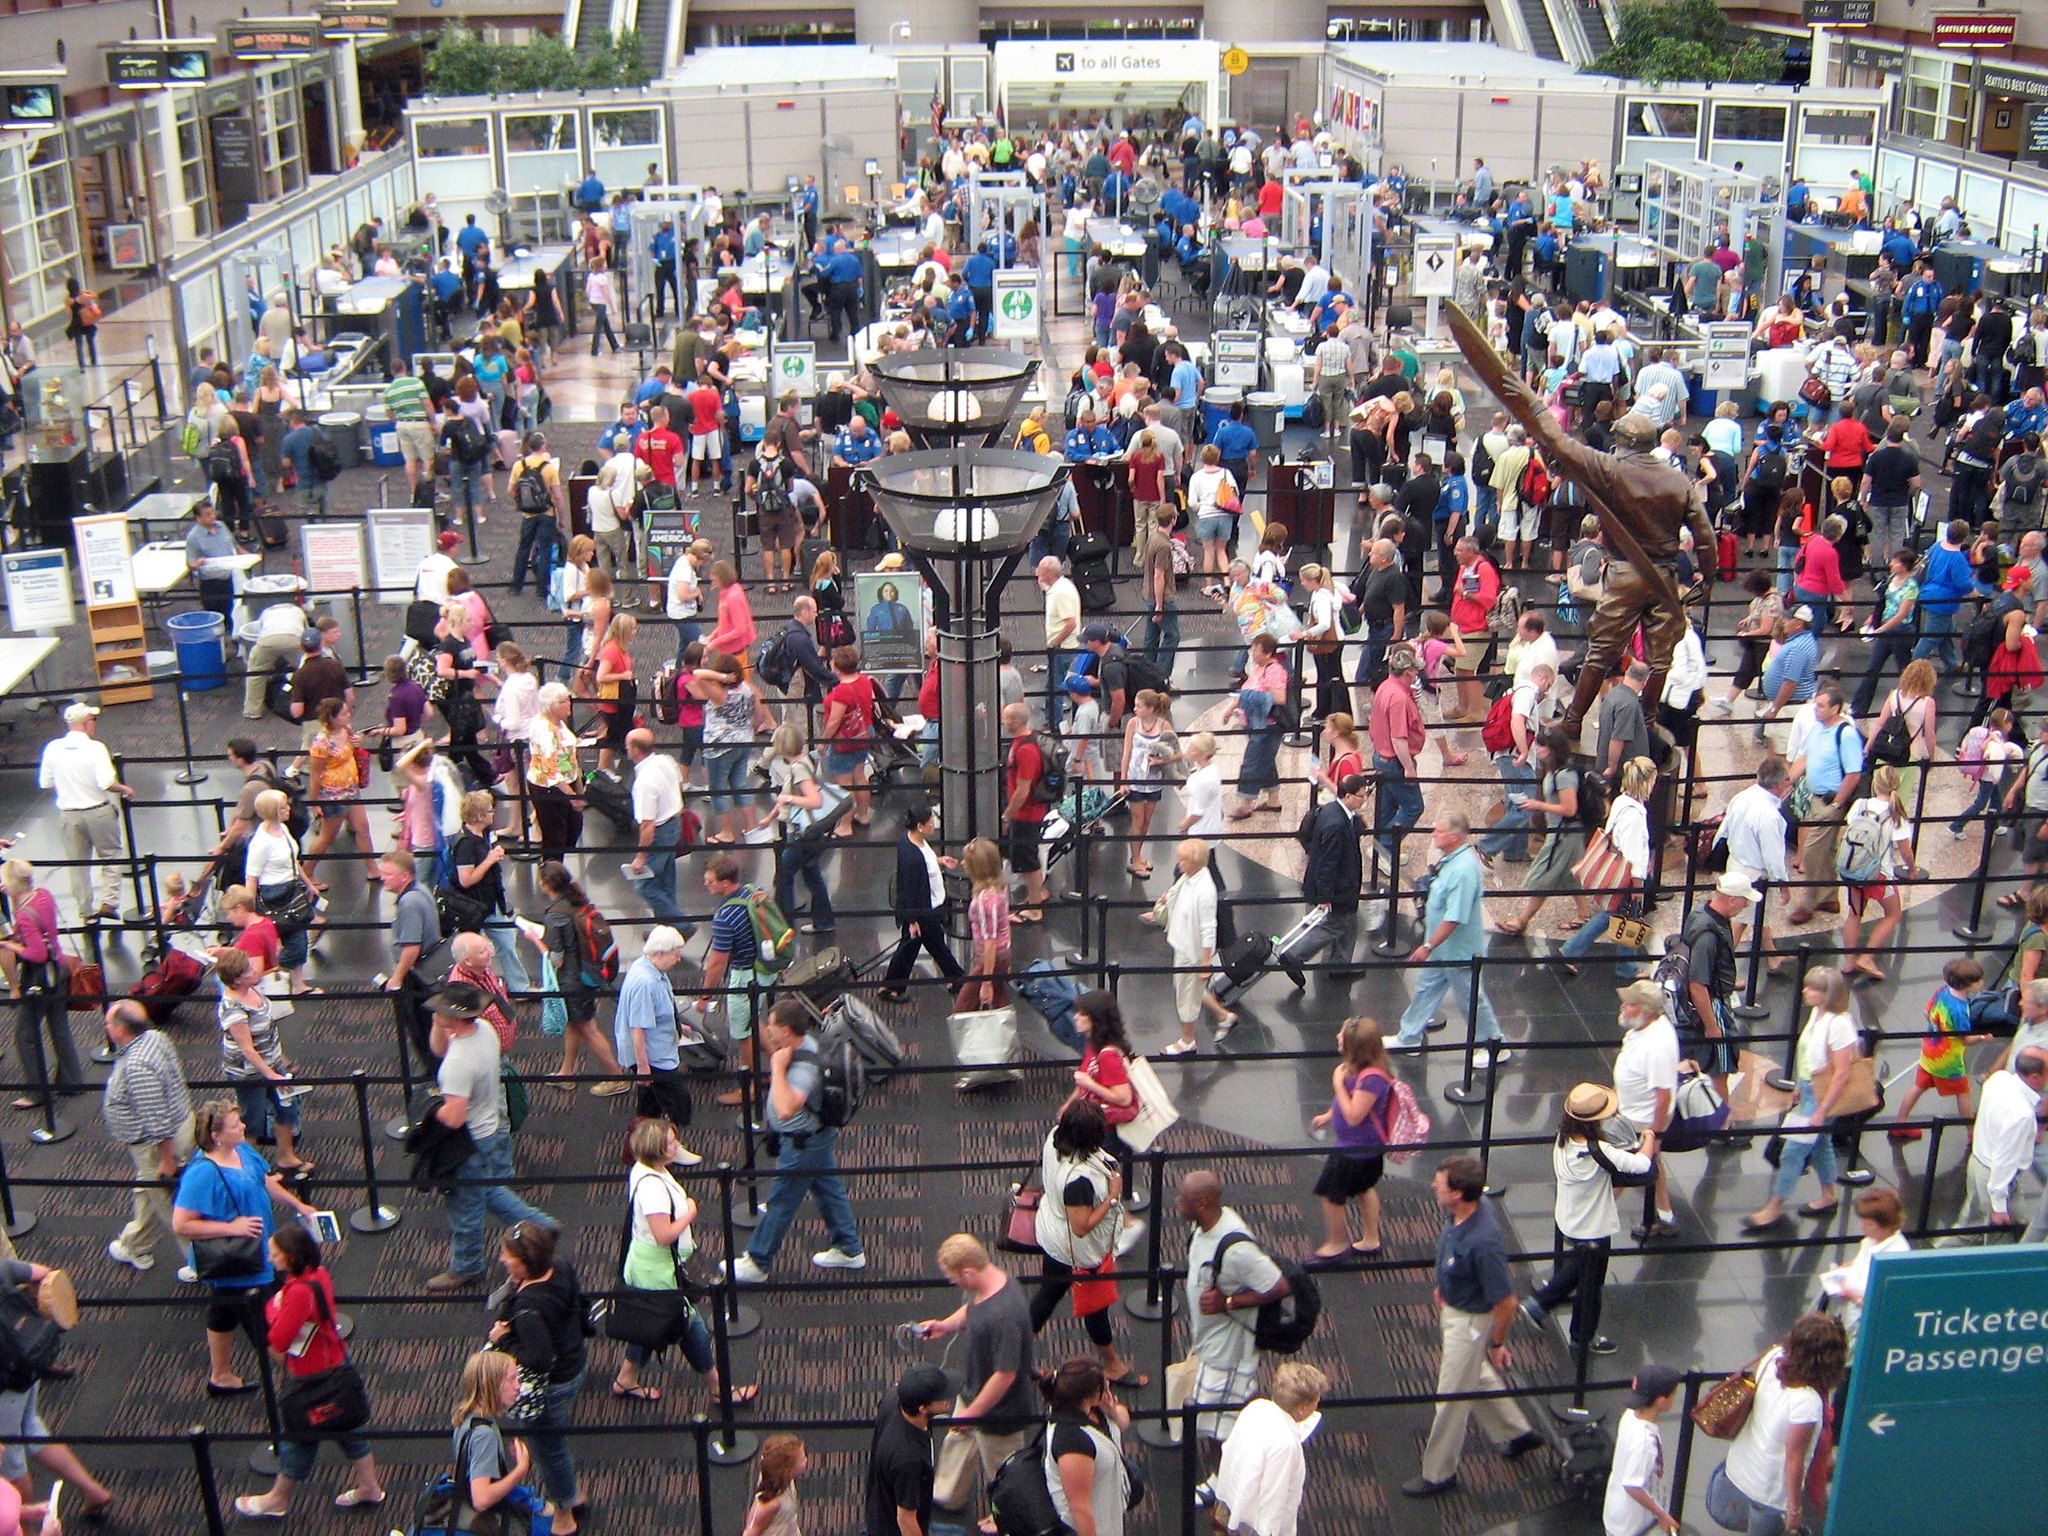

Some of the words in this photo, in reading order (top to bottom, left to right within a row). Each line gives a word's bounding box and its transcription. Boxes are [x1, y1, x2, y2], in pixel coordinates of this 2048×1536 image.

[1970, 24, 1987, 34] BEST
[1987, 24, 2013, 34] COFFEE
[1081, 57, 1096, 69] to
[1101, 56, 1117, 69] all
[1121, 56, 1161, 69] Gates
[2011, 78, 2026, 93] BEST
[651, 534, 693, 543] AMERICAS
[1885, 1344, 2048, 1374] Passenge
